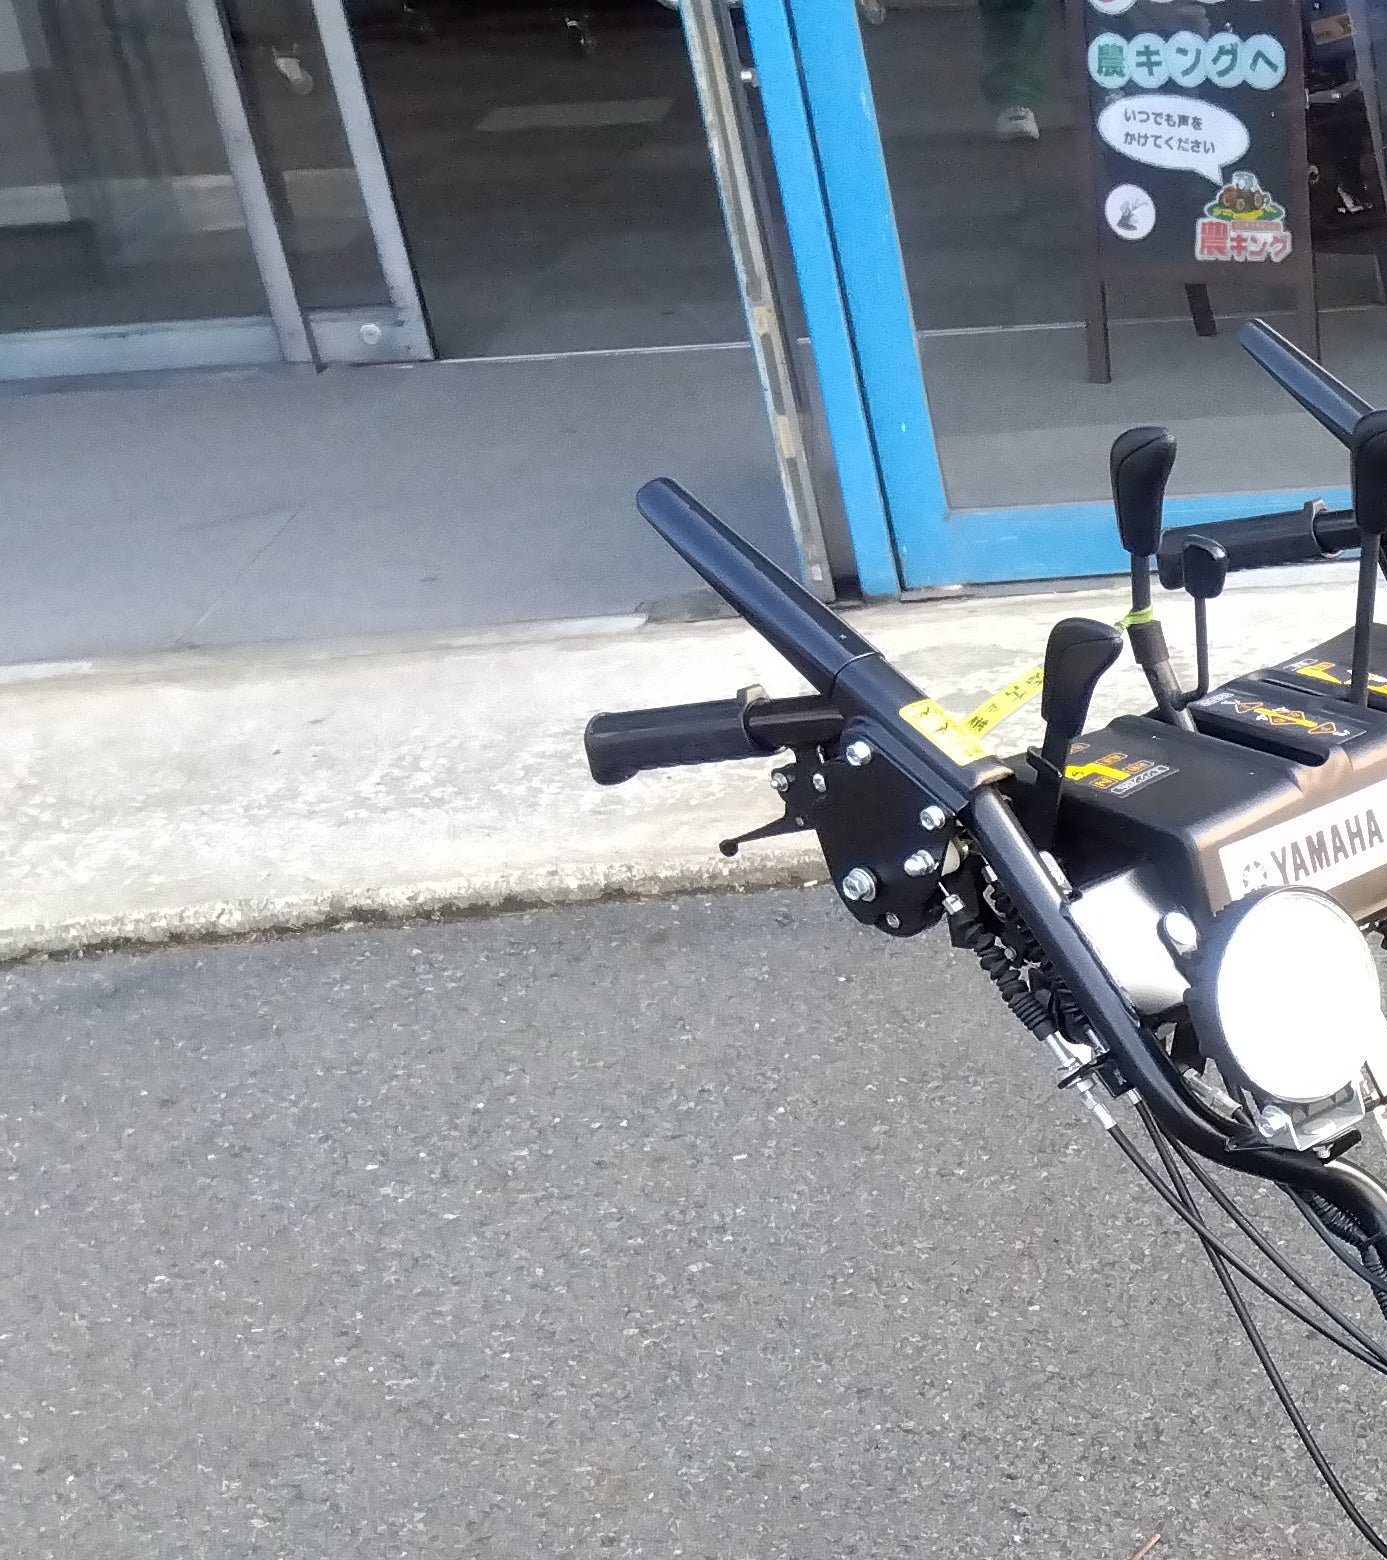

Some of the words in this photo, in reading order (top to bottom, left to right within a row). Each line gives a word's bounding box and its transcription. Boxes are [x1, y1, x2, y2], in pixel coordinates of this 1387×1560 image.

[1096, 41, 1279, 78] 農キングへ
[1123, 107, 1203, 131] いつでも声を
[1123, 131, 1216, 154] かけてください
[1269, 808, 1384, 886] YAMAHA
